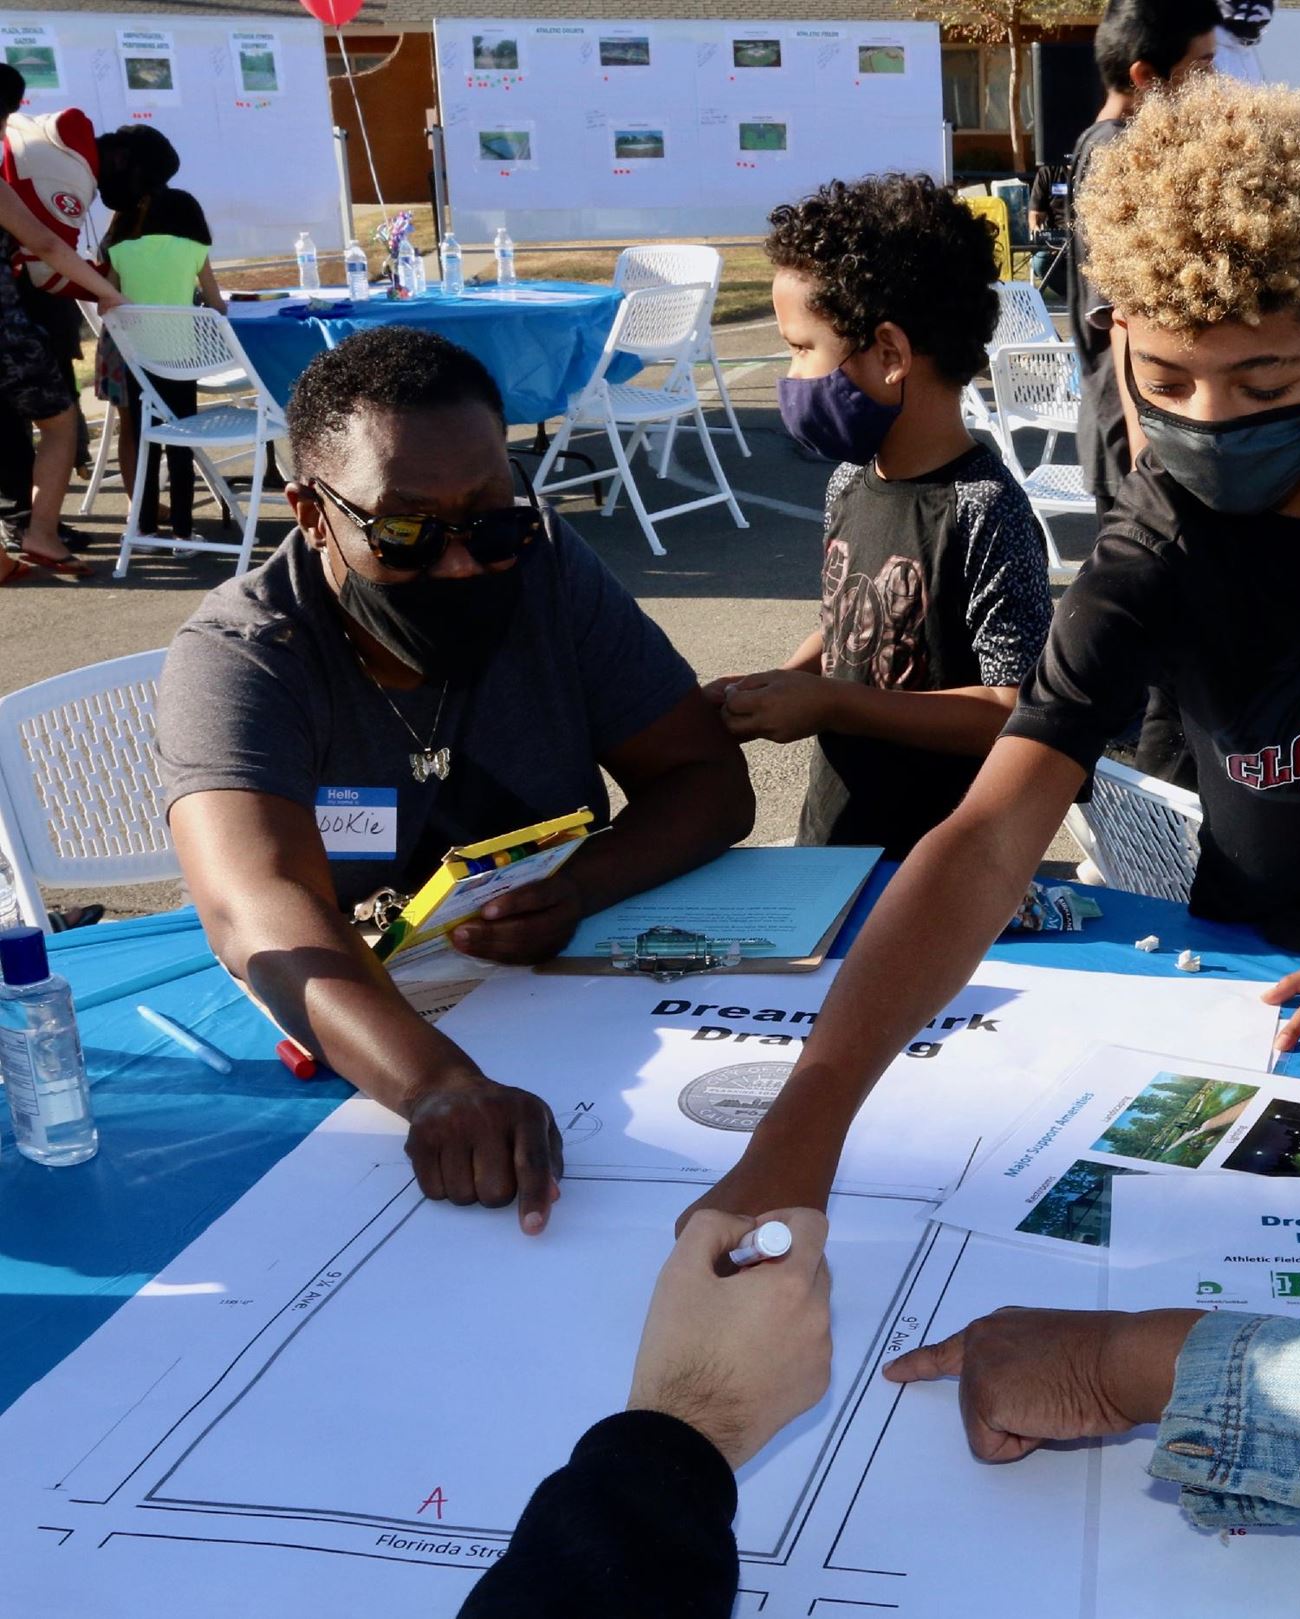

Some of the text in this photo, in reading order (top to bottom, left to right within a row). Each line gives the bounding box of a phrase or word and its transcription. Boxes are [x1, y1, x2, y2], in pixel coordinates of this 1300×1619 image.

[328, 789, 359, 800] Hello
[319, 811, 384, 834] ooKie
[574, 1102, 595, 1112] N
[1003, 1092, 1095, 1178] Major Support Amenities
[1024, 1176, 1056, 1204] Restrooms
[291, 1291, 322, 1311] Ave.
[887, 1331, 910, 1354] Ave.
[417, 1486, 448, 1520] A
[1229, 1528, 1248, 1536] 16
[375, 1534, 508, 1559] Florinda Stre
